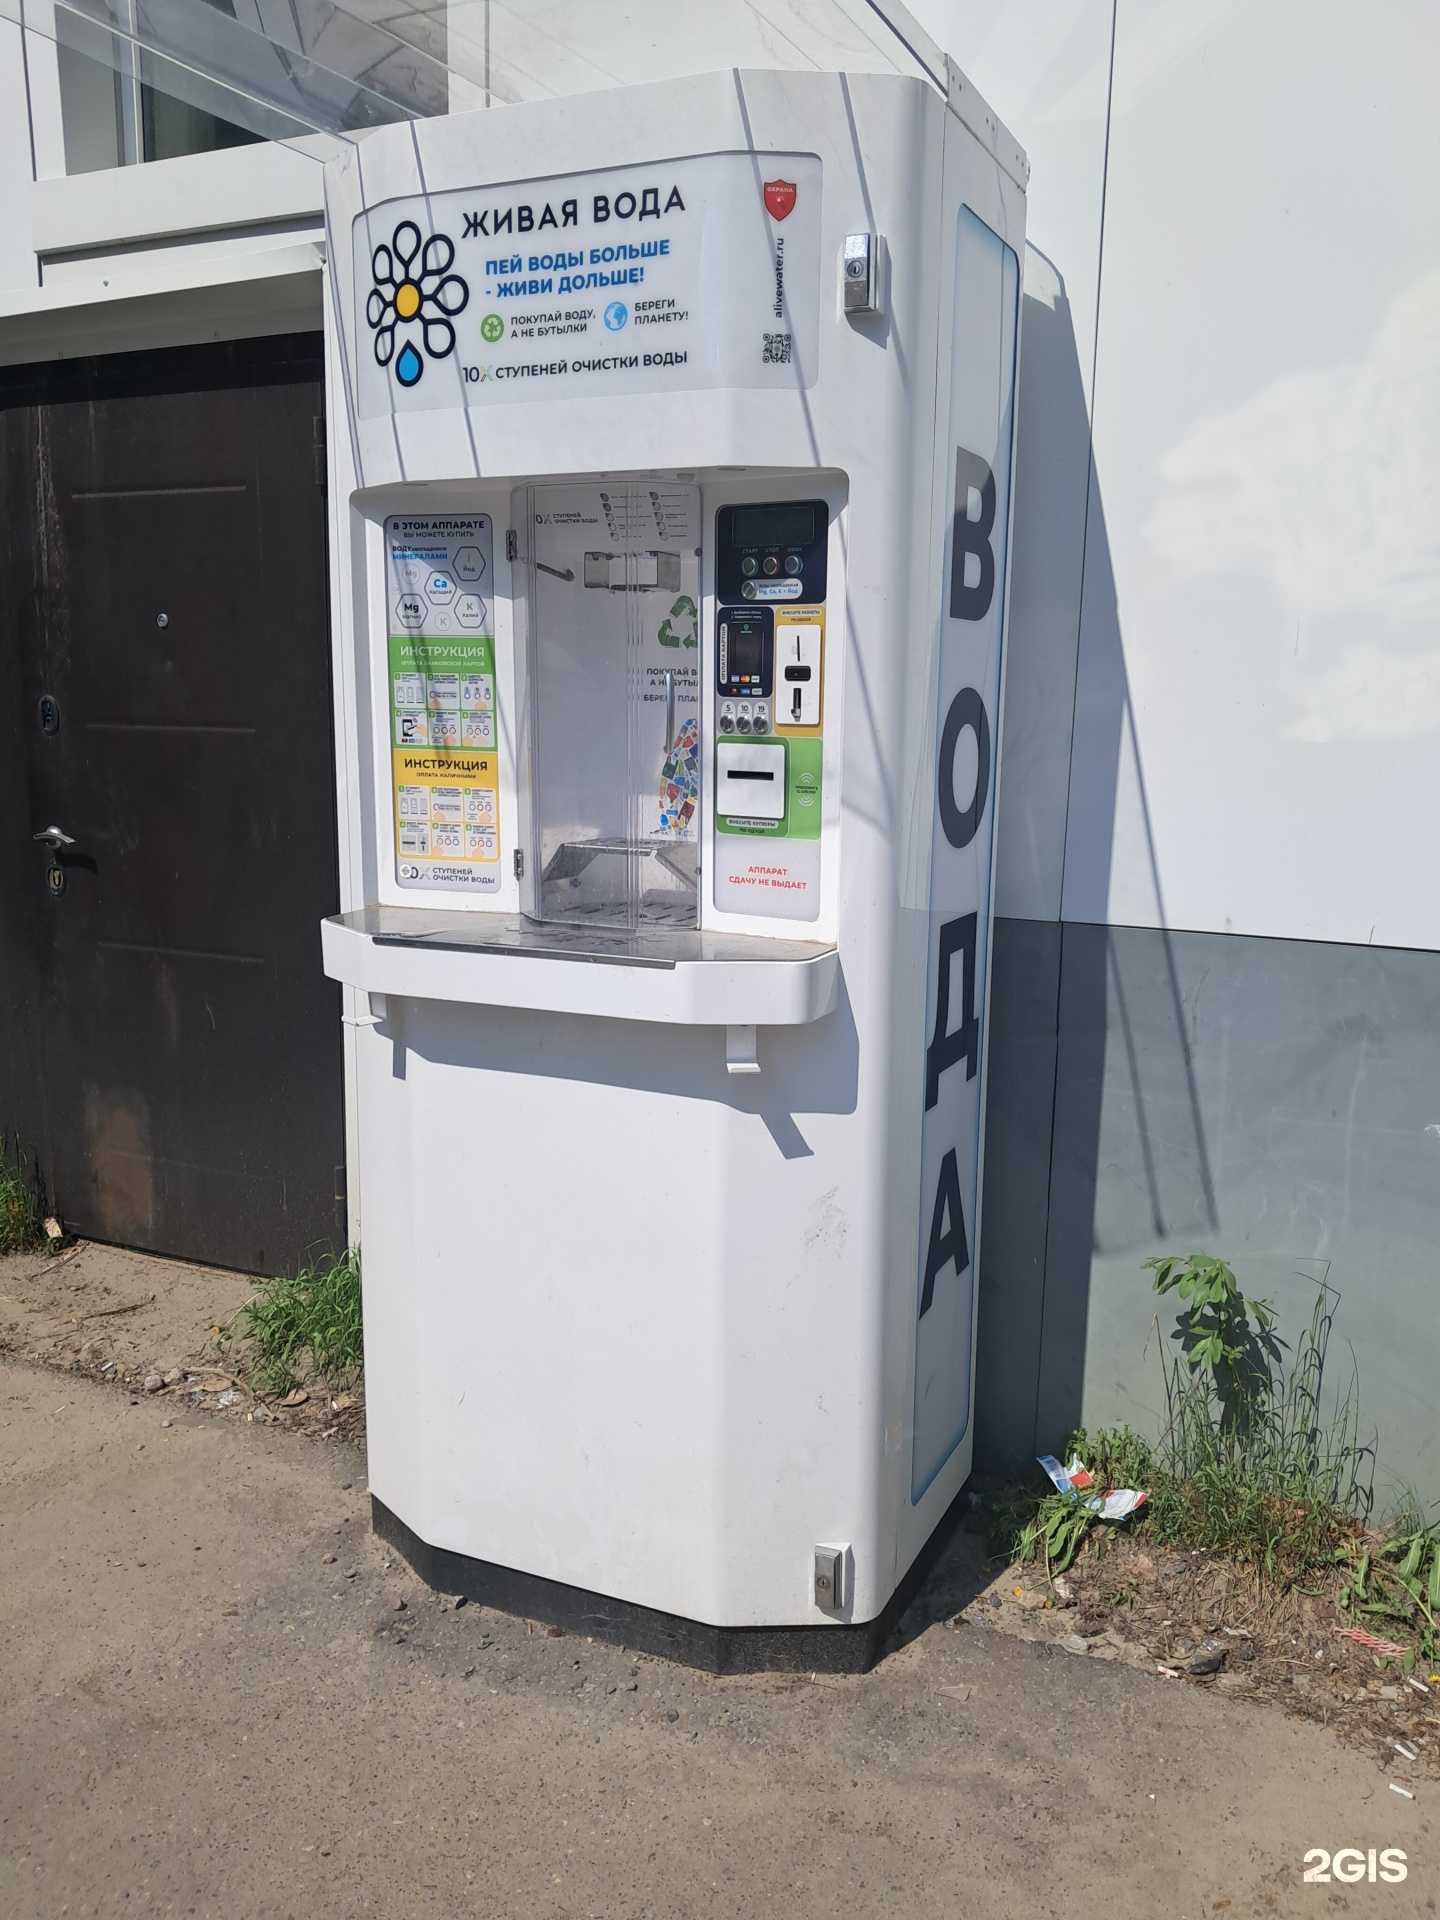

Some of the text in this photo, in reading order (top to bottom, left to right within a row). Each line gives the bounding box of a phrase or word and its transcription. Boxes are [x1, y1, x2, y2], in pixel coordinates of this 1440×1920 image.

[461, 185, 686, 239] ЖИВАЯ ВОДА
[485, 239, 671, 276] ПЕЙ ВОДЫ БОЛЬШЕ
[496, 276, 553, 298] ЖИВИ
[558, 267, 645, 295] ДОЛЬШЕ!
[773, 238, 784, 318] alivewater.ru
[634, 298, 675, 313] БЕРЕГИ
[511, 309, 596, 326] ПОКУПАЙ ВОДУ,
[634, 310, 689, 326] ПЛАНЕТУ!
[511, 322, 588, 338] А НЕ БУТЫЛКИ
[496, 359, 568, 379] СТУПЕНЕЙ
[571, 355, 639, 374] ОЧИСТКИ
[642, 350, 688, 368] ВОДЫ
[393, 520, 485, 530] В ЭТОМ АППАРАТЕ
[392, 552, 448, 560] МИНЕРАЛАМИ
[433, 579, 449, 588] Ca
[404, 603, 419, 613] Mg
[400, 646, 485, 658] ИНСТРУКЦИЯ
[647, 667, 688, 676] ПОКУПАЙ
[726, 704, 731, 712] 5
[741, 704, 749, 712] 10
[404, 758, 488, 771] ИНСТРУКЦИЯ
[432, 867, 473, 876] СТУПЕНЕЙ
[747, 866, 788, 876] АППАРАТ
[432, 874, 496, 885] ОЧИСТКИ ВОДЫ
[729, 875, 808, 890] СДАЧУ НЕ ВЫДАЕТ
[919, 446, 995, 1320] ВОДА
